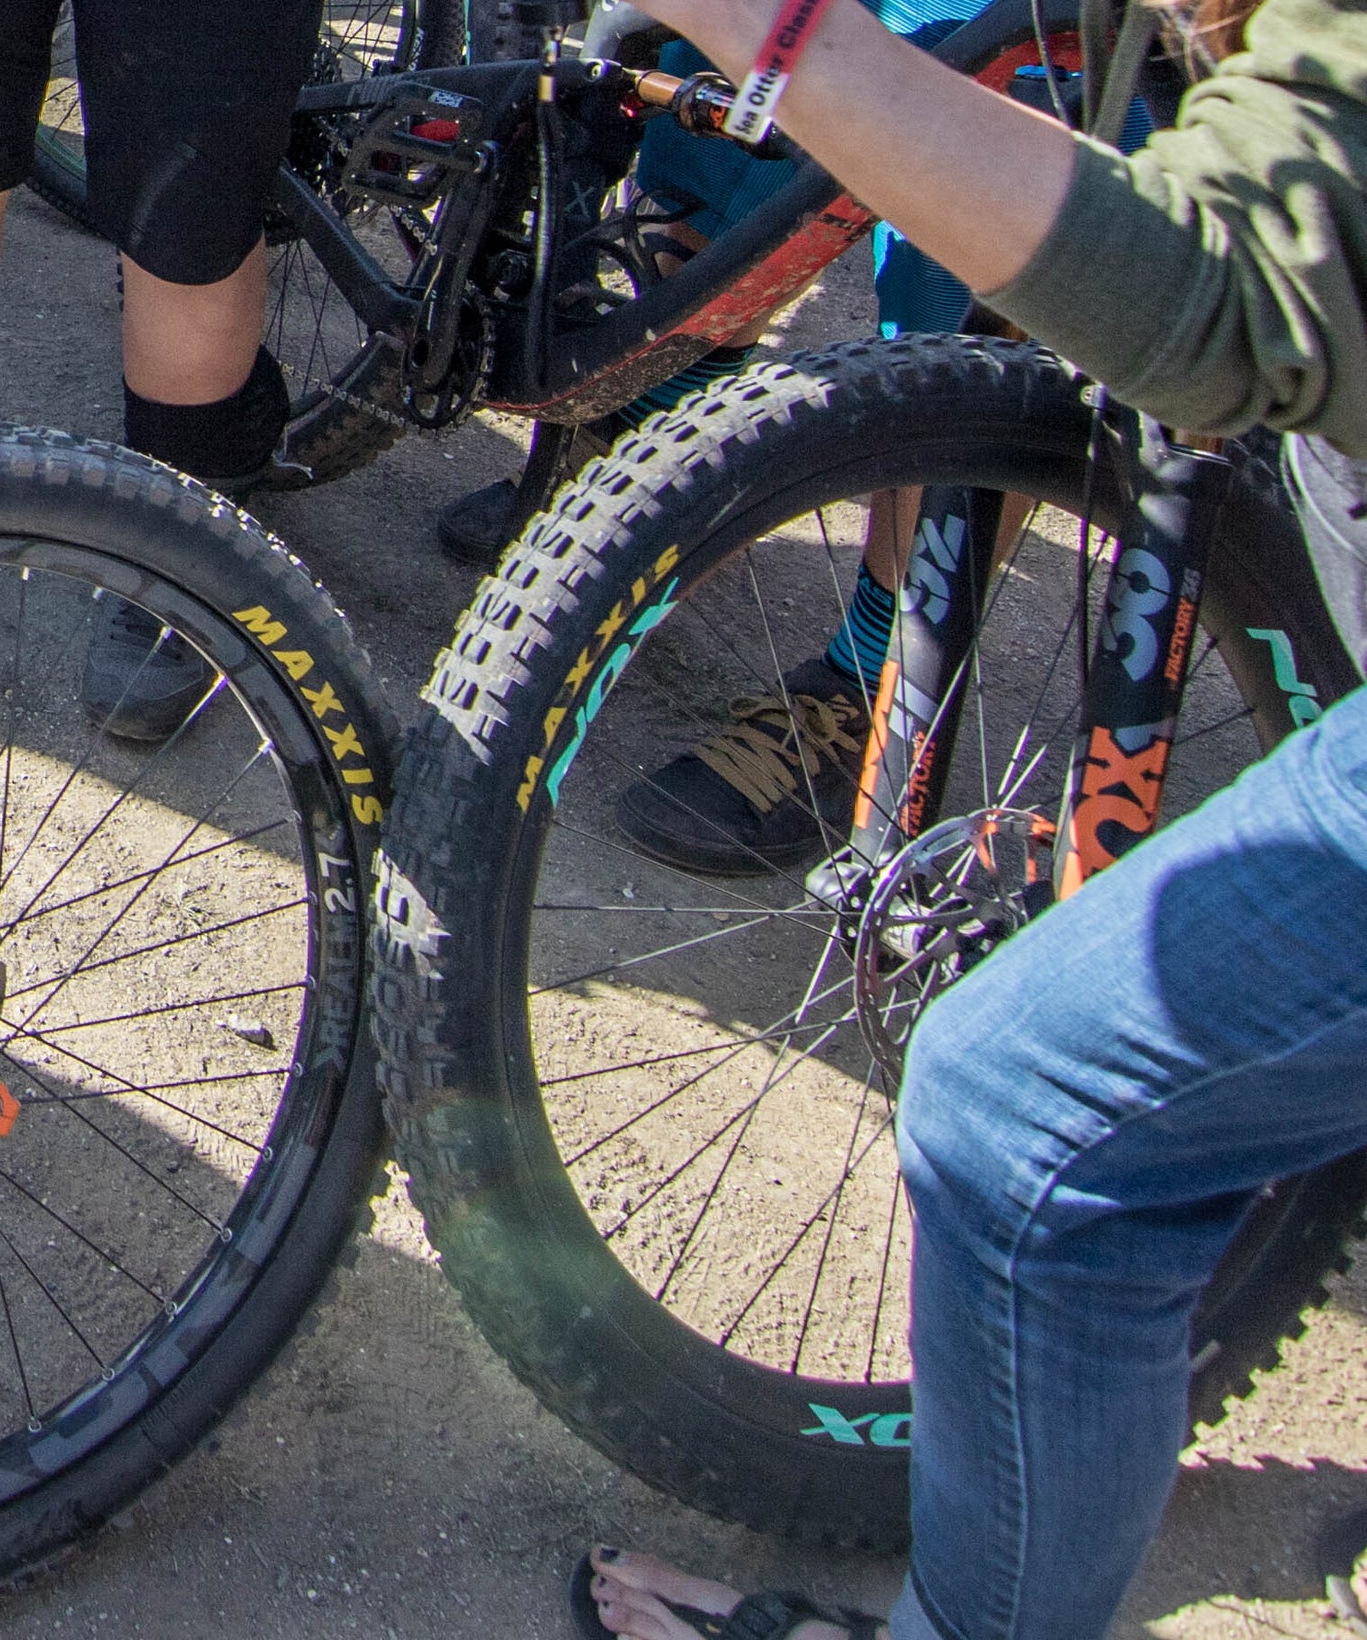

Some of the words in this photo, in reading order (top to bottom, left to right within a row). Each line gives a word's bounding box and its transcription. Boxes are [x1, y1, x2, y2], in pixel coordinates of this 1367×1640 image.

[748, 54, 785, 106] Otter
[232, 602, 385, 826] MAXXIS
[514, 543, 681, 813] MAXXIS
[1245, 627, 1323, 730] NO
[318, 851, 357, 915] 2.7
[799, 1402, 914, 1448] OX
